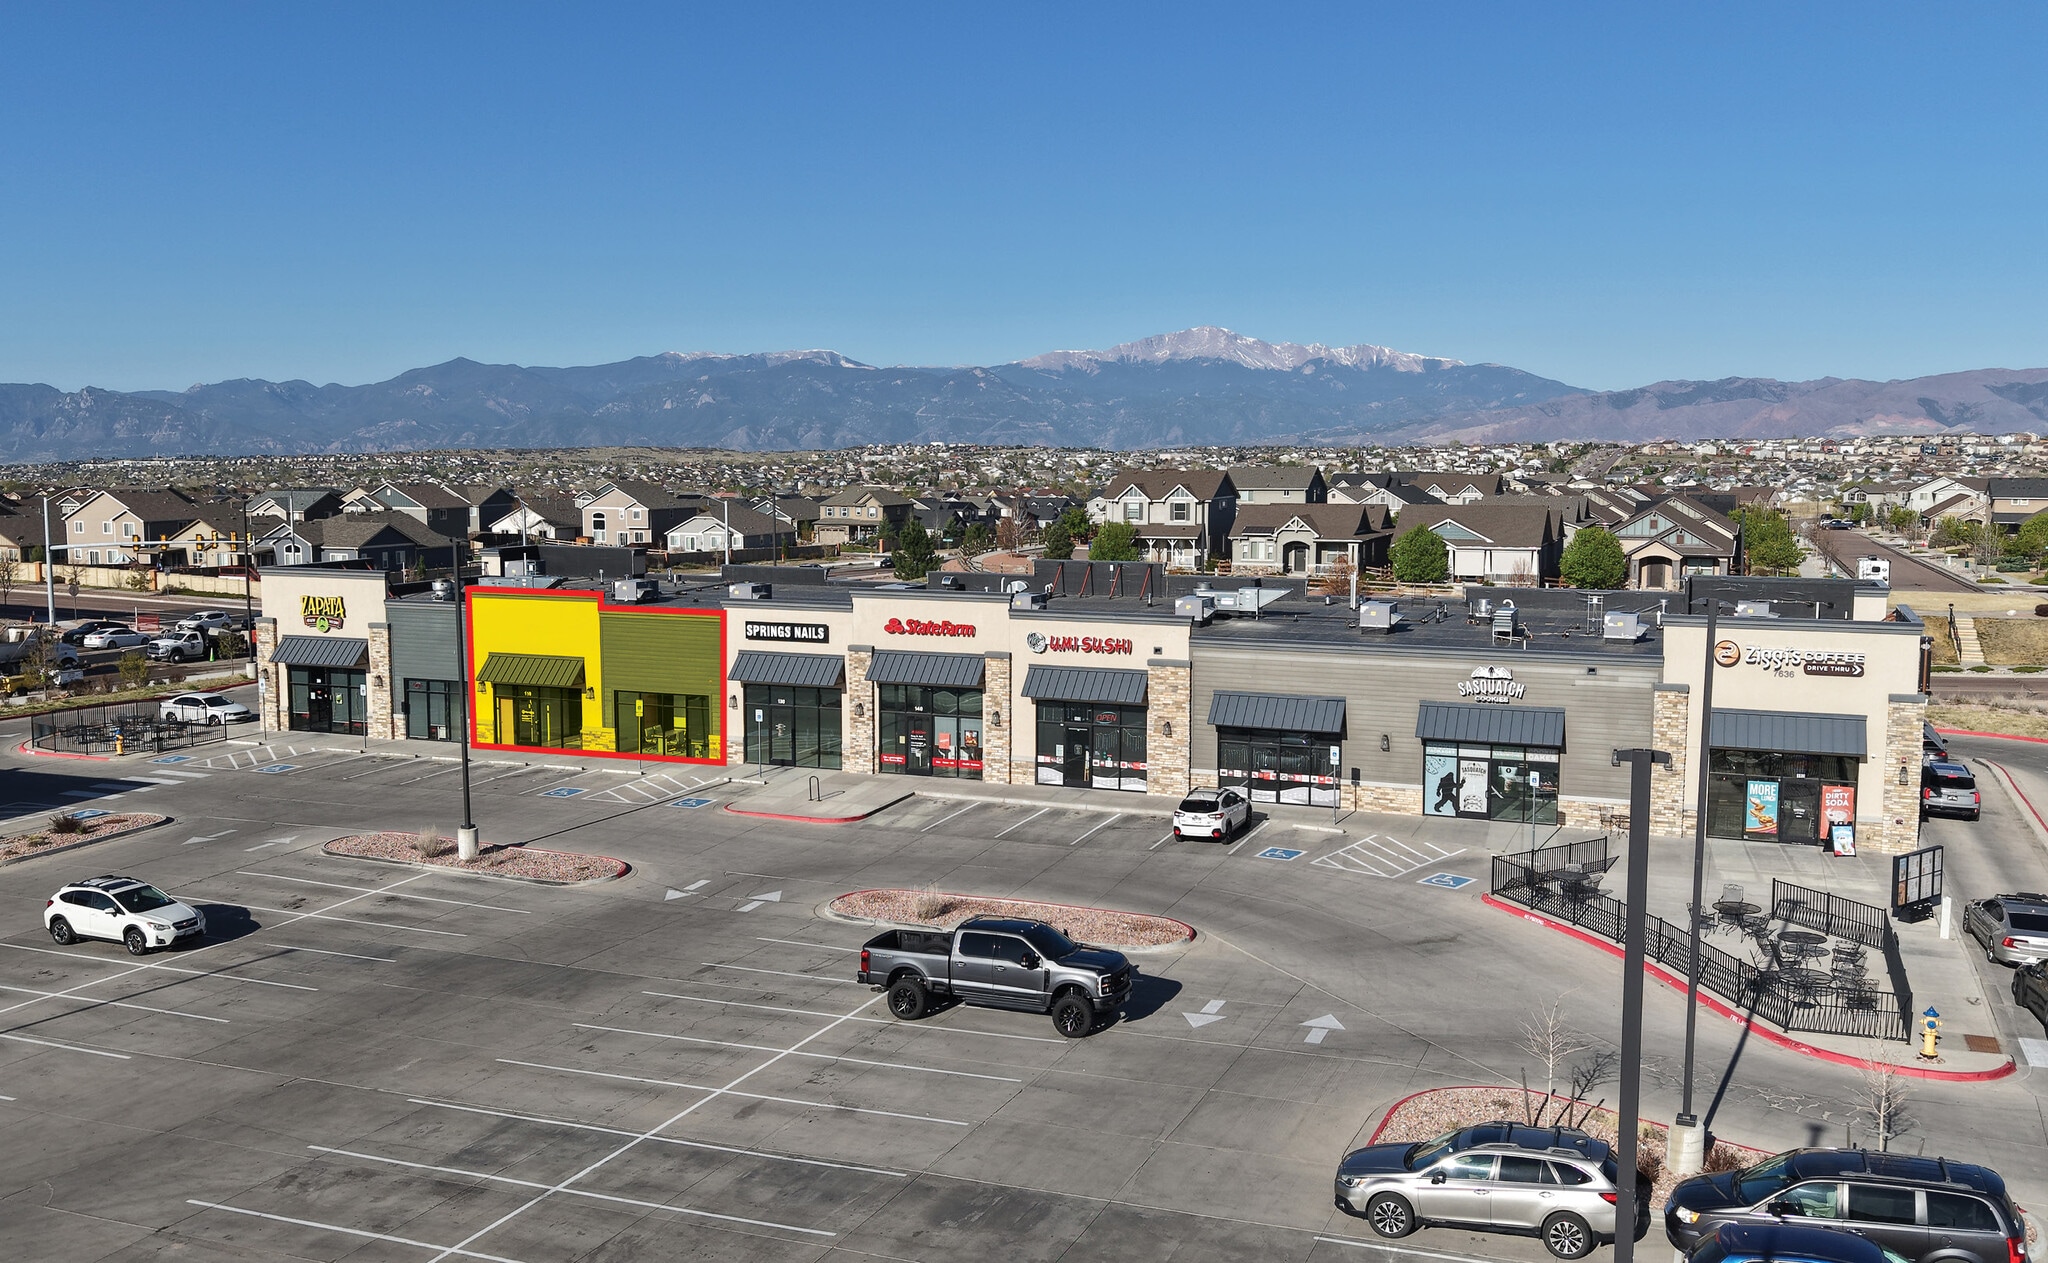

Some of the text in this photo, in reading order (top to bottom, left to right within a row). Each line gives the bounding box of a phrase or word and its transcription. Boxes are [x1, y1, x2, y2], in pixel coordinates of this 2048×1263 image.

[300, 595, 346, 618] ZAPATA
[746, 624, 825, 640] SPRINGS NAILS
[1049, 635, 1132, 655] UMI SUSHI
[1745, 645, 1865, 671] Ziggi's COFFEE
[1807, 664, 1850, 673] DRIVE THRU
[1774, 670, 1795, 679] 7636
[1457, 679, 1526, 701] SASQUATCH
[1474, 695, 1509, 704] COOKIES
[1095, 714, 1117, 722] OPEN
[1528, 754, 1557, 762] CAKES
[1750, 783, 1777, 796] MORE
[1825, 792, 1849, 800] DIRTY
[1825, 799, 1849, 807] SODA
